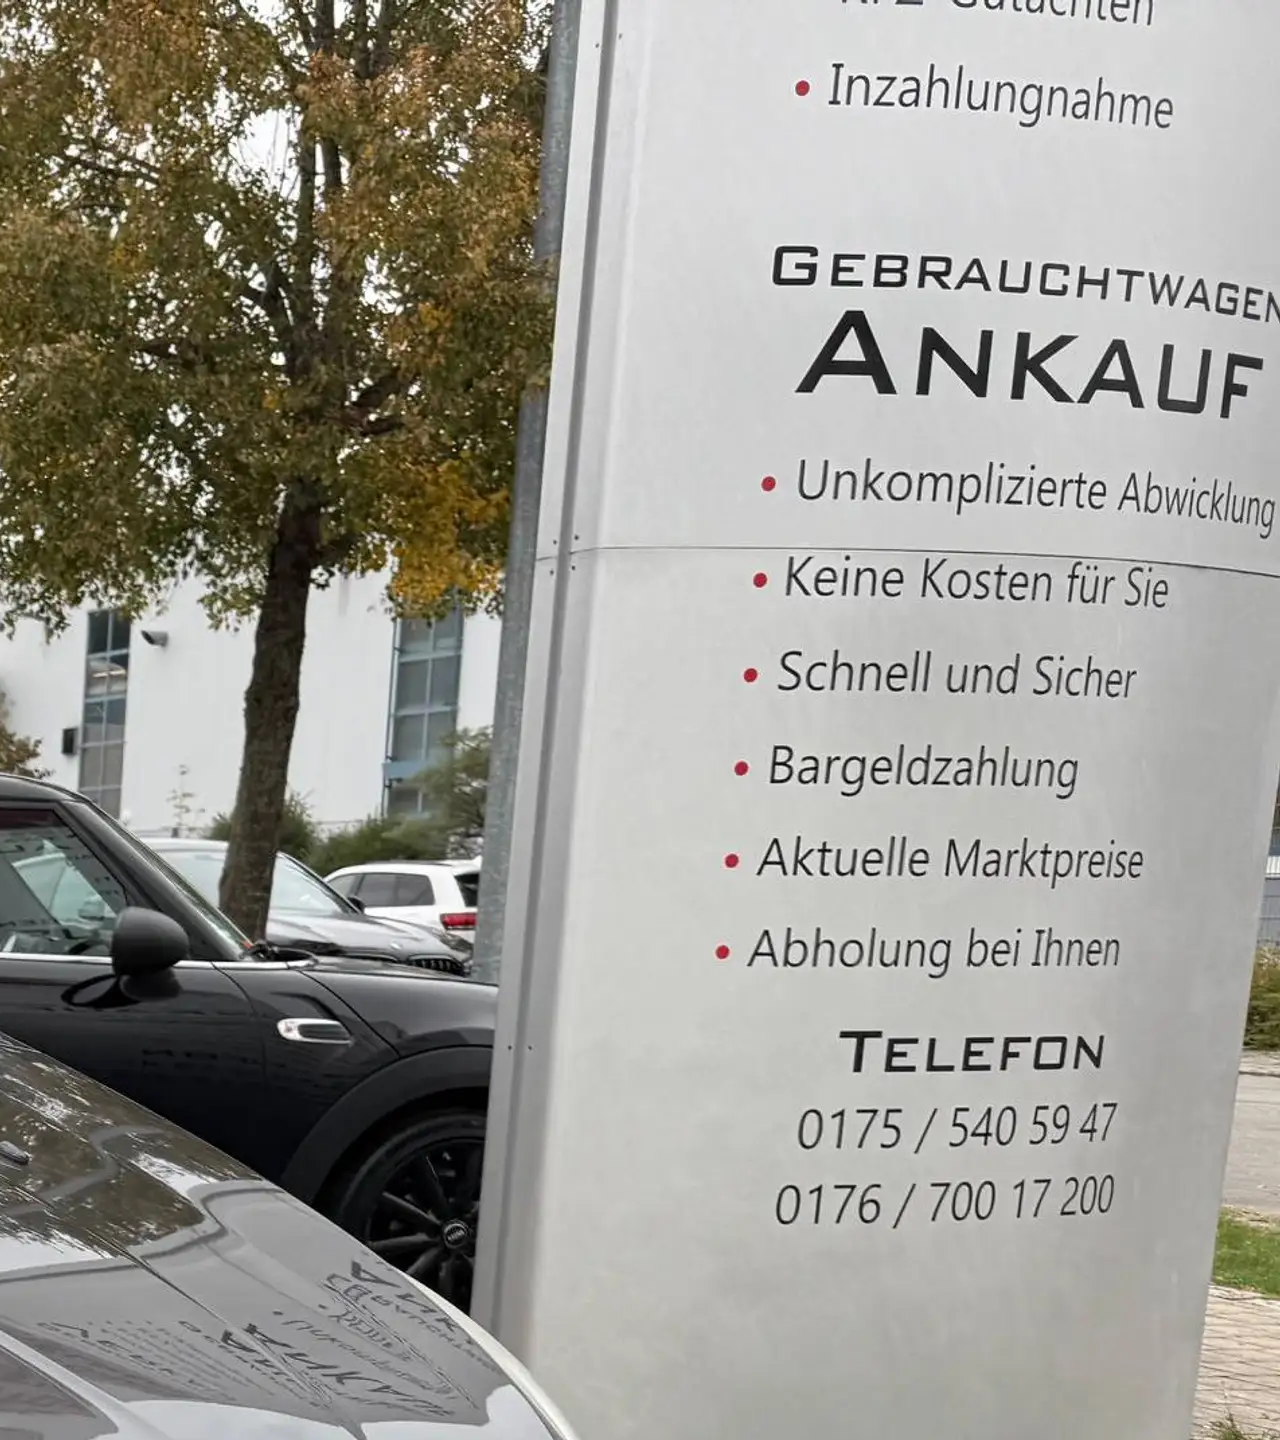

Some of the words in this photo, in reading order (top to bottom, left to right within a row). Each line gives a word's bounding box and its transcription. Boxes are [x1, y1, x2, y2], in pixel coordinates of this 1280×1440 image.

[828, 63, 1173, 128] Inzahlungnahme
[772, 246, 1280, 323] GEBRAUCHTWAGEN
[795, 310, 1264, 419] ANKAUF
[798, 458, 1106, 515] Unkomplizierte
[1117, 471, 1277, 539] Abwicklung
[786, 555, 904, 597] Keine
[921, 558, 1052, 601] Kosten
[1068, 561, 1115, 604] für
[1124, 567, 1168, 608] Sie
[777, 649, 931, 692] Schnell
[947, 653, 1020, 694] und
[1033, 655, 1137, 698] Sicher
[770, 744, 1078, 800] Bargeldzahlung
[756, 836, 930, 877] Aktuelle
[945, 837, 1143, 889] Marktpreise
[747, 927, 951, 979] Abholung
[967, 927, 1022, 967] bei
[1031, 927, 1119, 966] Ihnen
[839, 1031, 1104, 1073] TELEFON
[798, 1108, 903, 1150] 0175
[949, 1106, 1016, 1147] 540
[1029, 1105, 1070, 1145] 59
[1079, 1103, 1118, 1142] 47
[776, 1184, 881, 1225] 0176
[930, 1181, 996, 1221] 700
[1013, 1179, 1052, 1218] 17
[1060, 1175, 1114, 1216] 200
